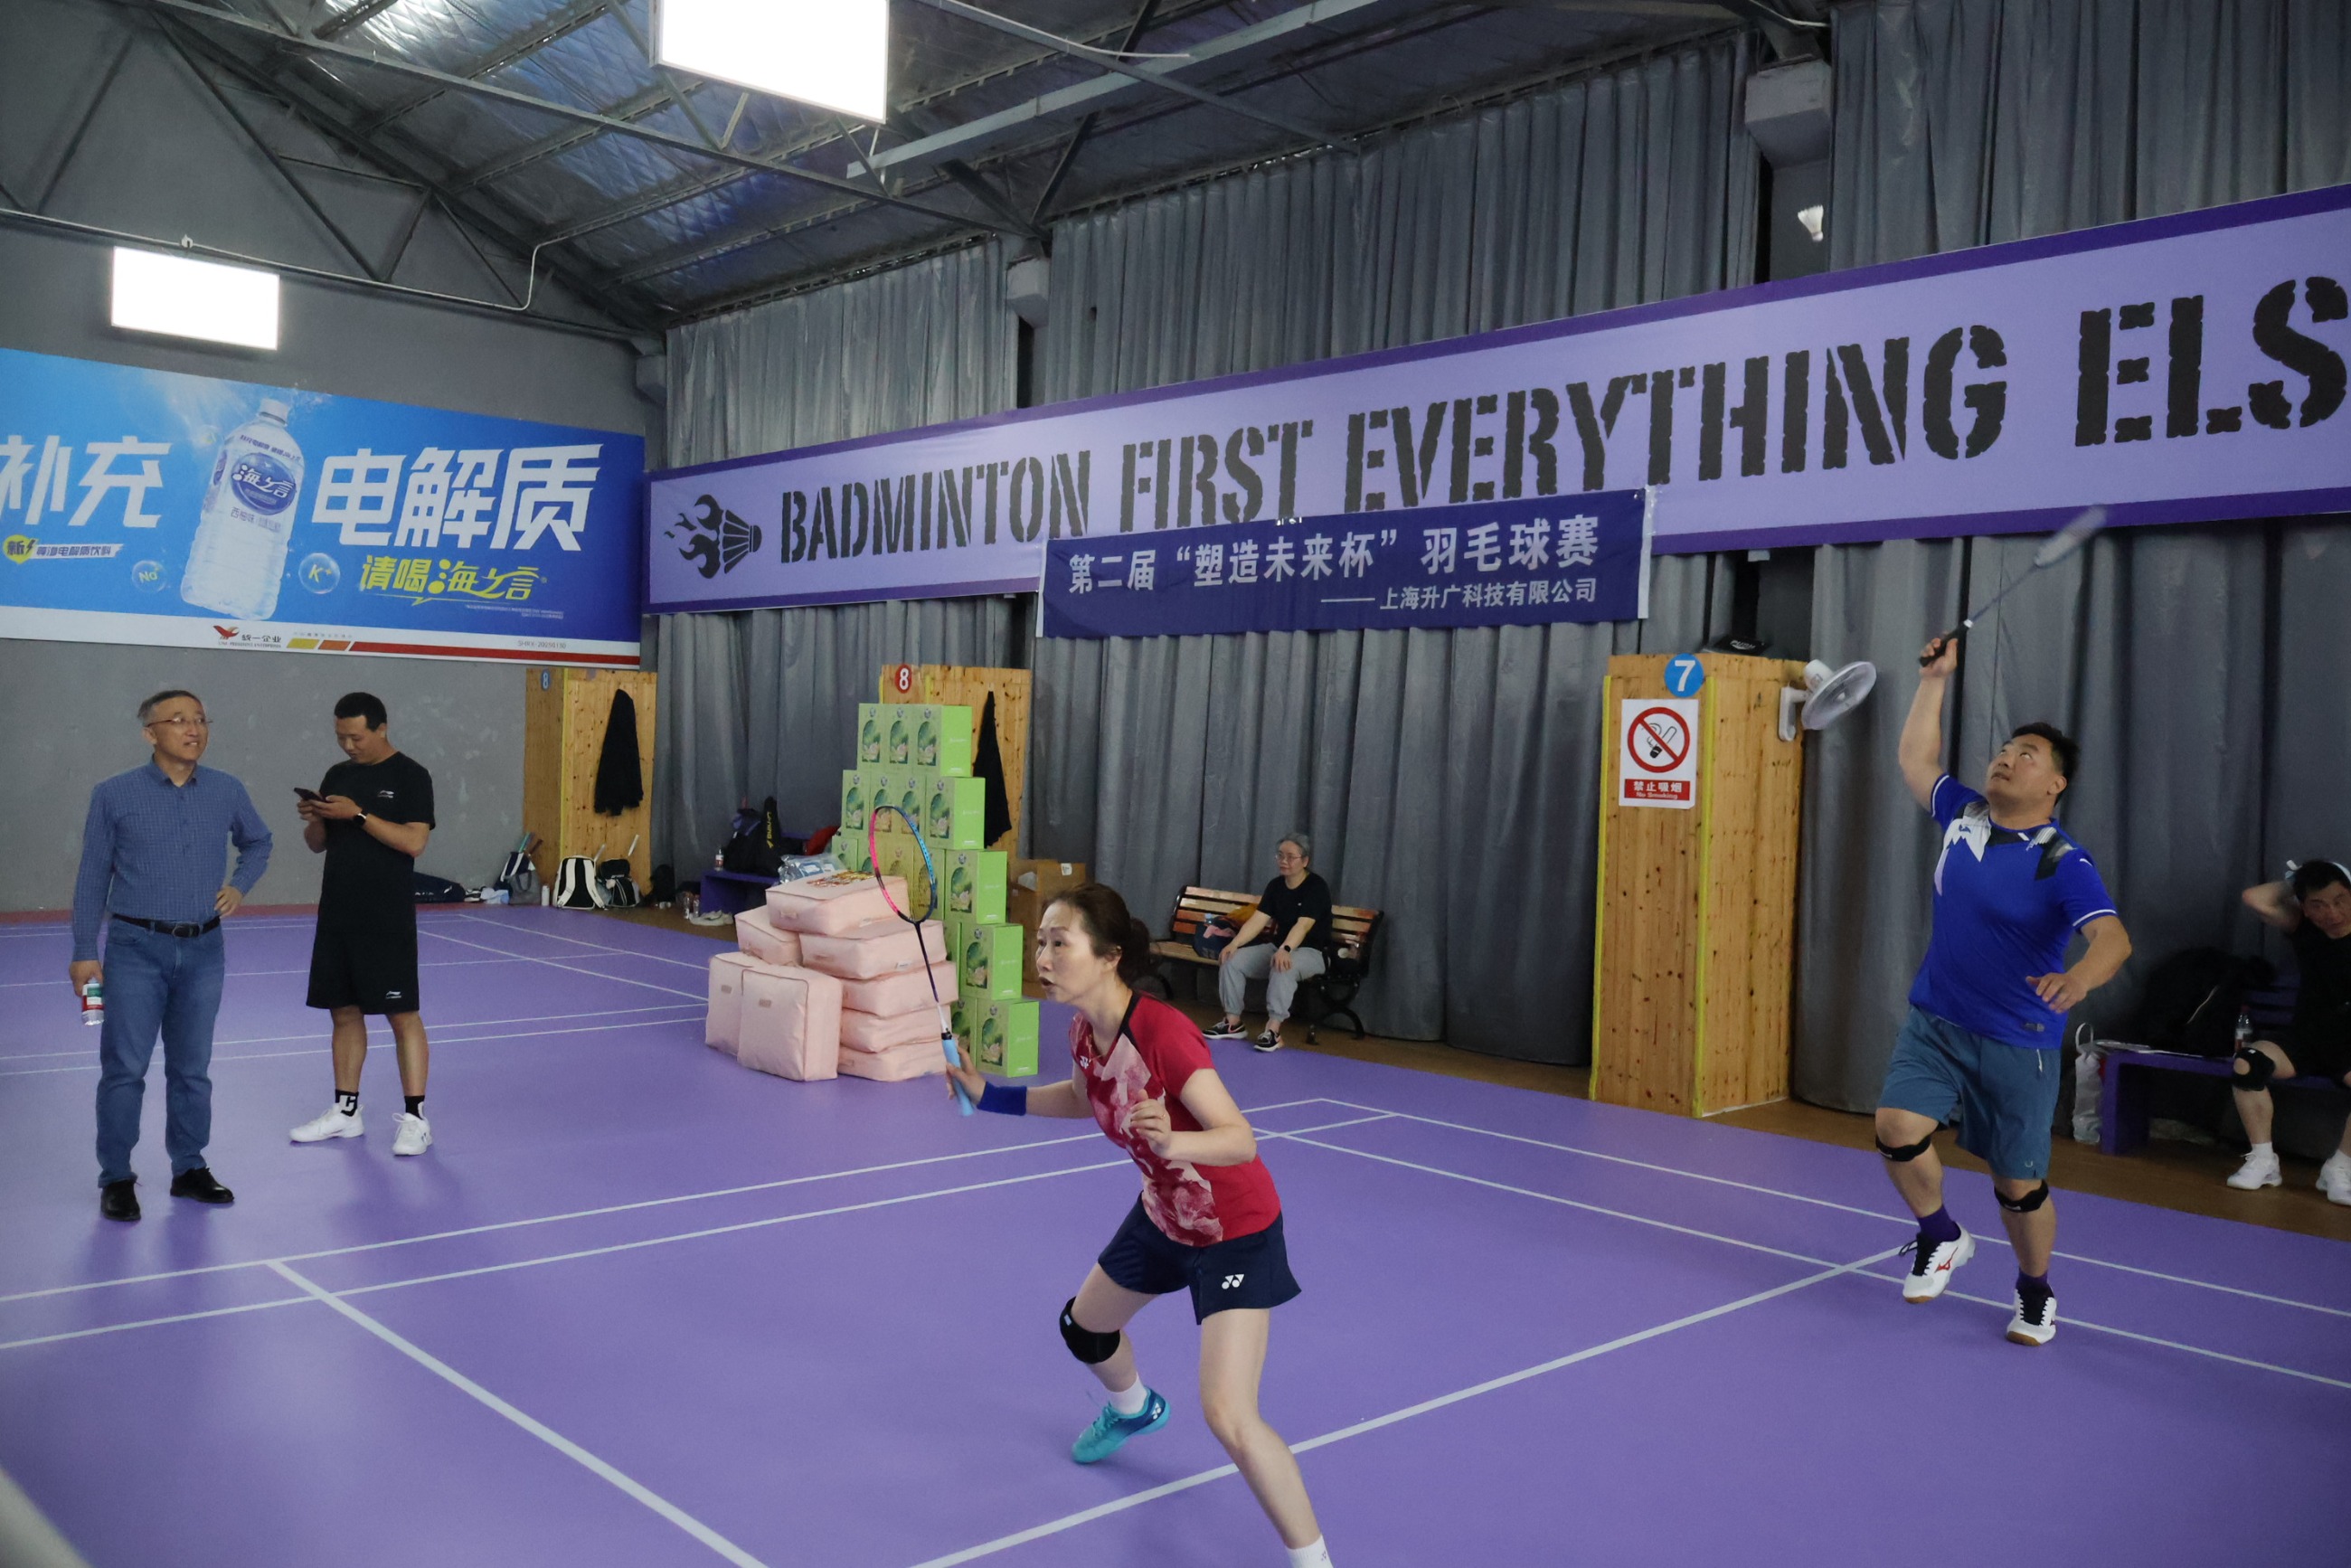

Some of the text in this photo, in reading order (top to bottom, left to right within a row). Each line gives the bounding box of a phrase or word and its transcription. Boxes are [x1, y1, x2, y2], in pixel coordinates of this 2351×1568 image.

[780, 275, 2349, 563] BADMINTON FIRST EVERYTHING ELS
[0, 435, 173, 528] 补充
[311, 443, 604, 553] 电解质
[360, 555, 540, 600] 请喝海之言
[1068, 515, 1600, 595] 第二届 “塑造未来杯” 羽毛球赛
[899, 667, 910, 690] 8
[1675, 659, 1696, 692] 7
[1633, 780, 1683, 793] 禁止吸烟
